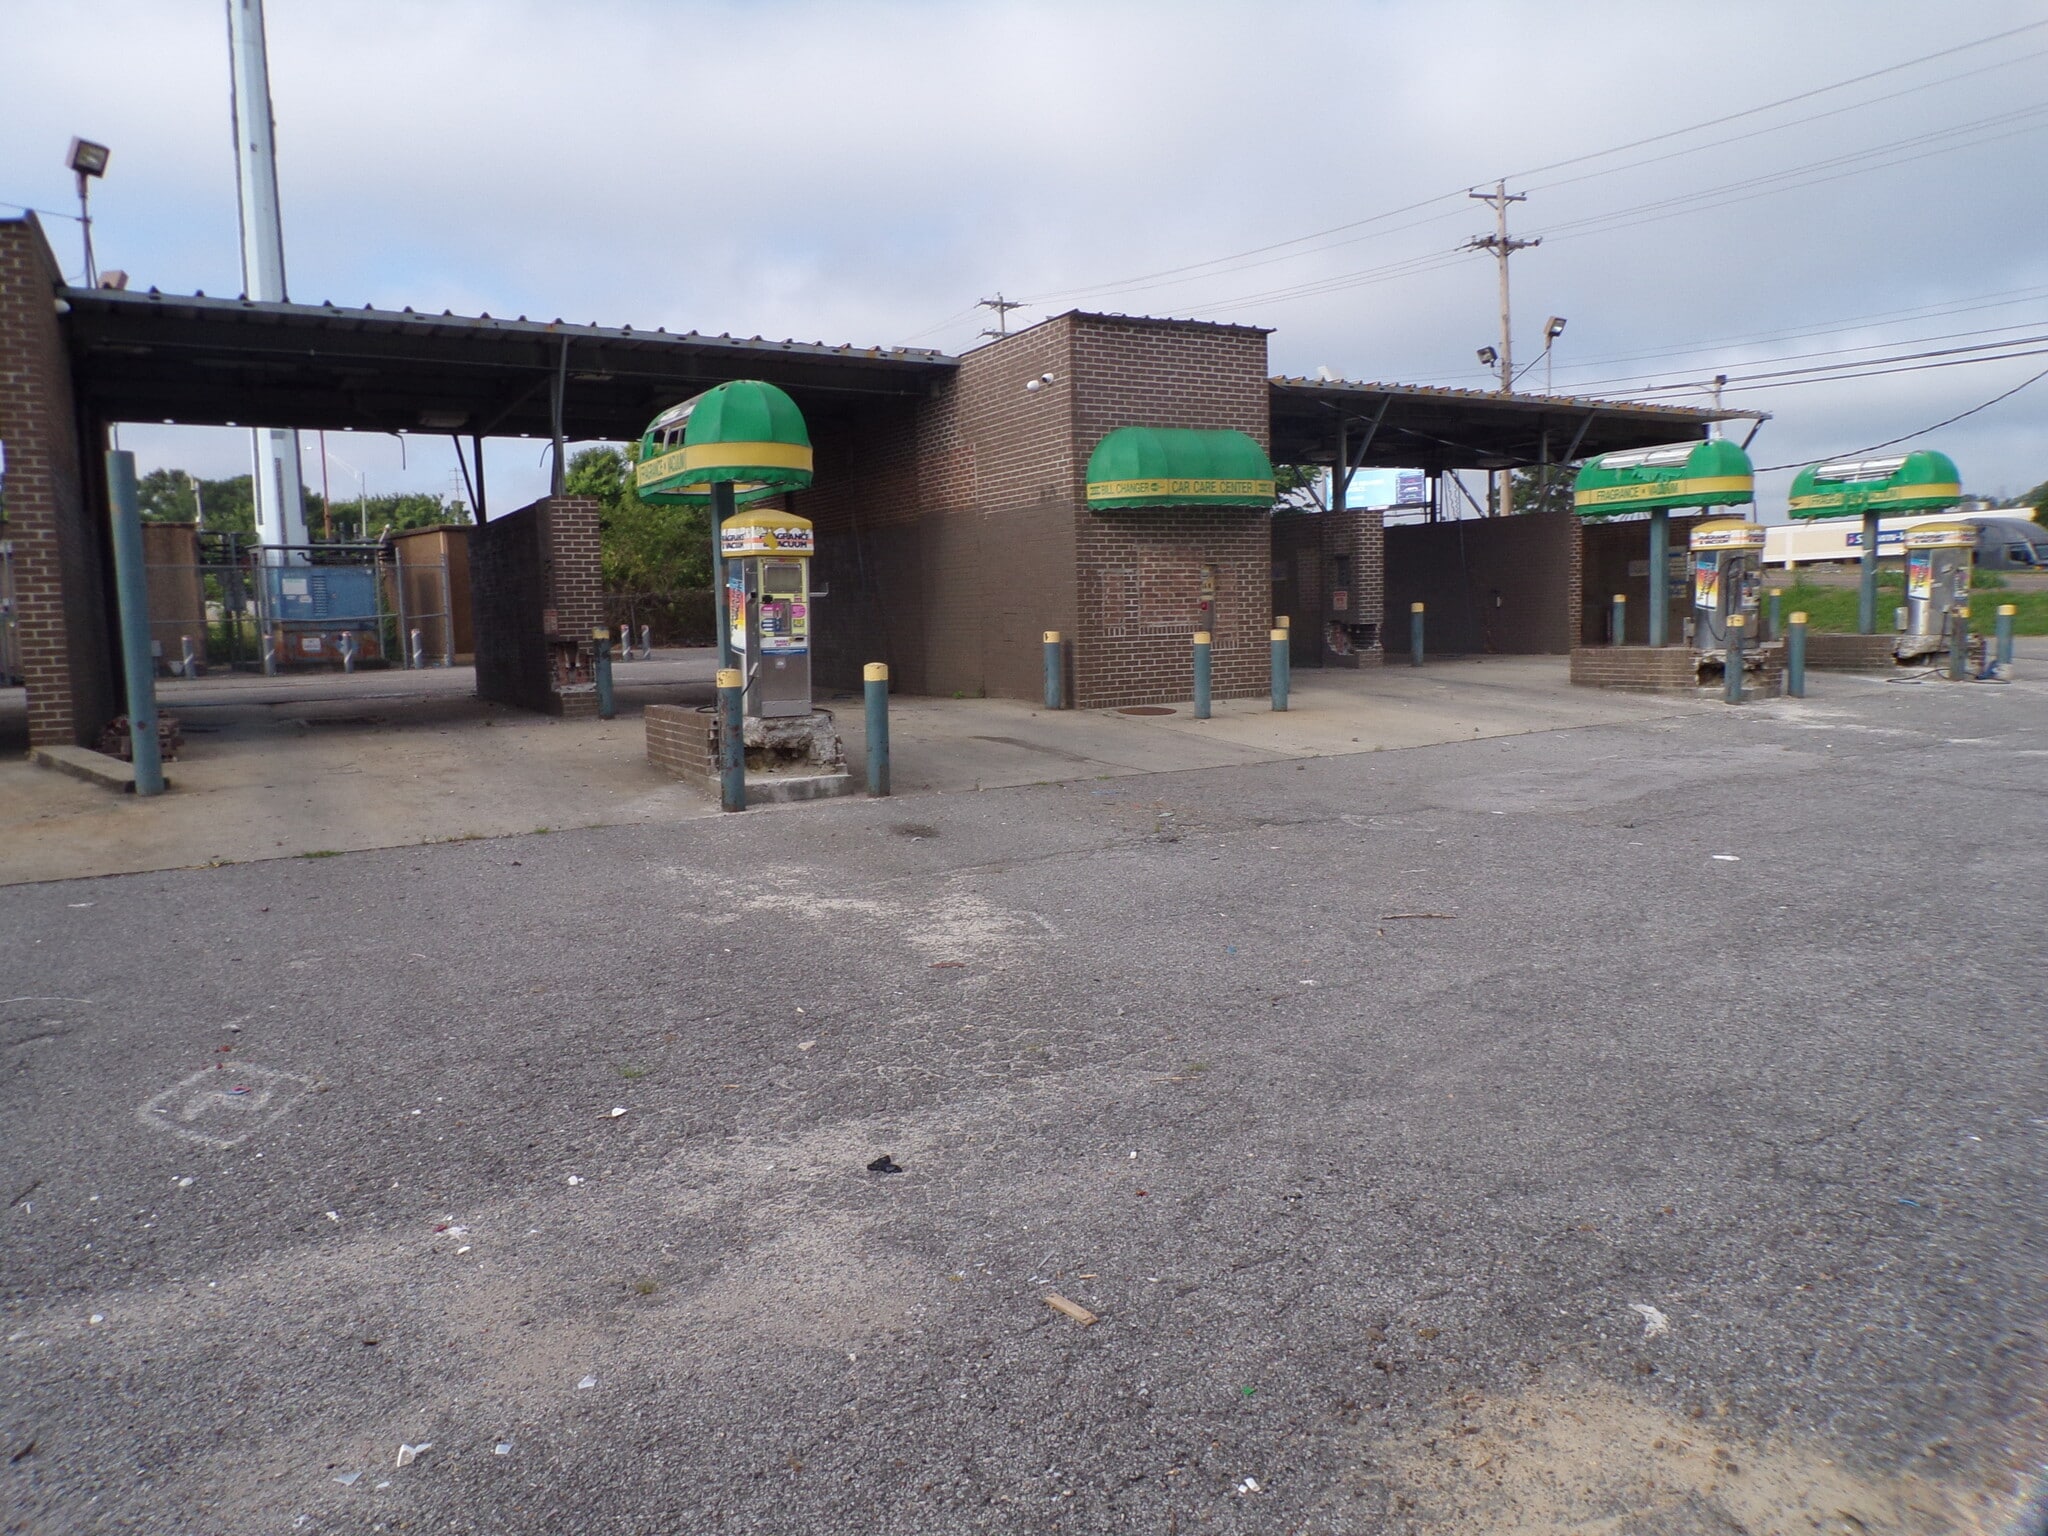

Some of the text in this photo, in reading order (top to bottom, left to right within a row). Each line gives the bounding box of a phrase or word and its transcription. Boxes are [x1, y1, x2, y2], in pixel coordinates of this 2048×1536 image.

[1116, 482, 1149, 494] CHANGER
[1171, 481, 1253, 493] CAR CARE CENTER
[1597, 486, 1640, 500] FRAGRANCE
